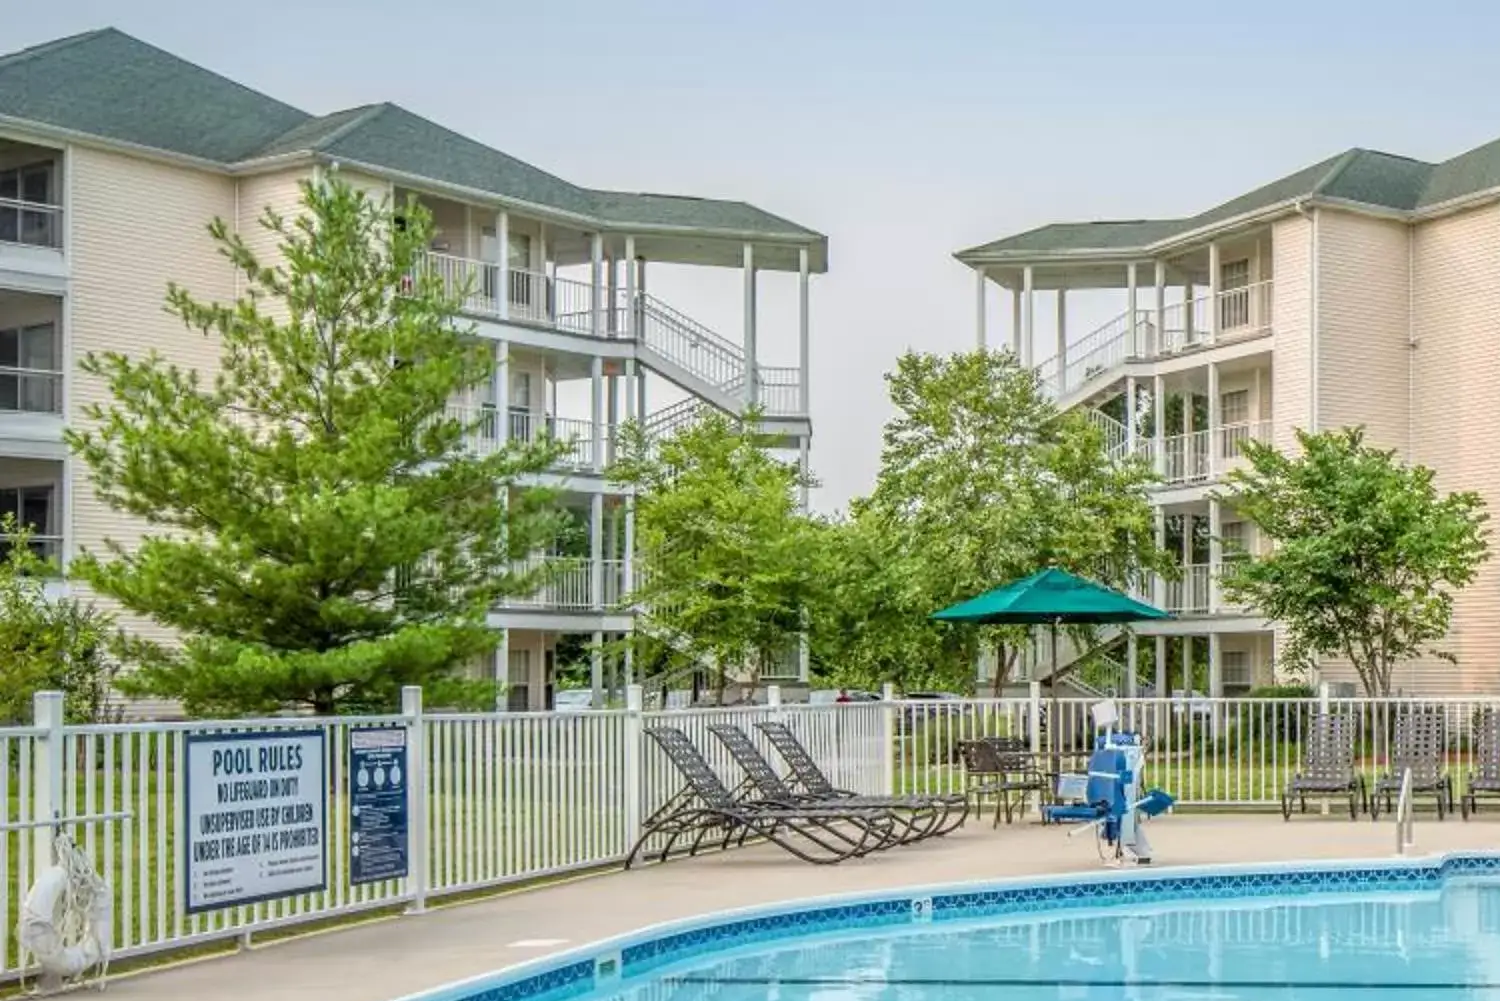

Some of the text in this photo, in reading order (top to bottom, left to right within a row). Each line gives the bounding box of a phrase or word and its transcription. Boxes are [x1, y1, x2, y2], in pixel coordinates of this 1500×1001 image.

[212, 744, 303, 776] POOL RULES
[217, 782, 229, 803] NO
[230, 779, 268, 802] LIFEGUARD
[194, 838, 220, 862] UNDER
